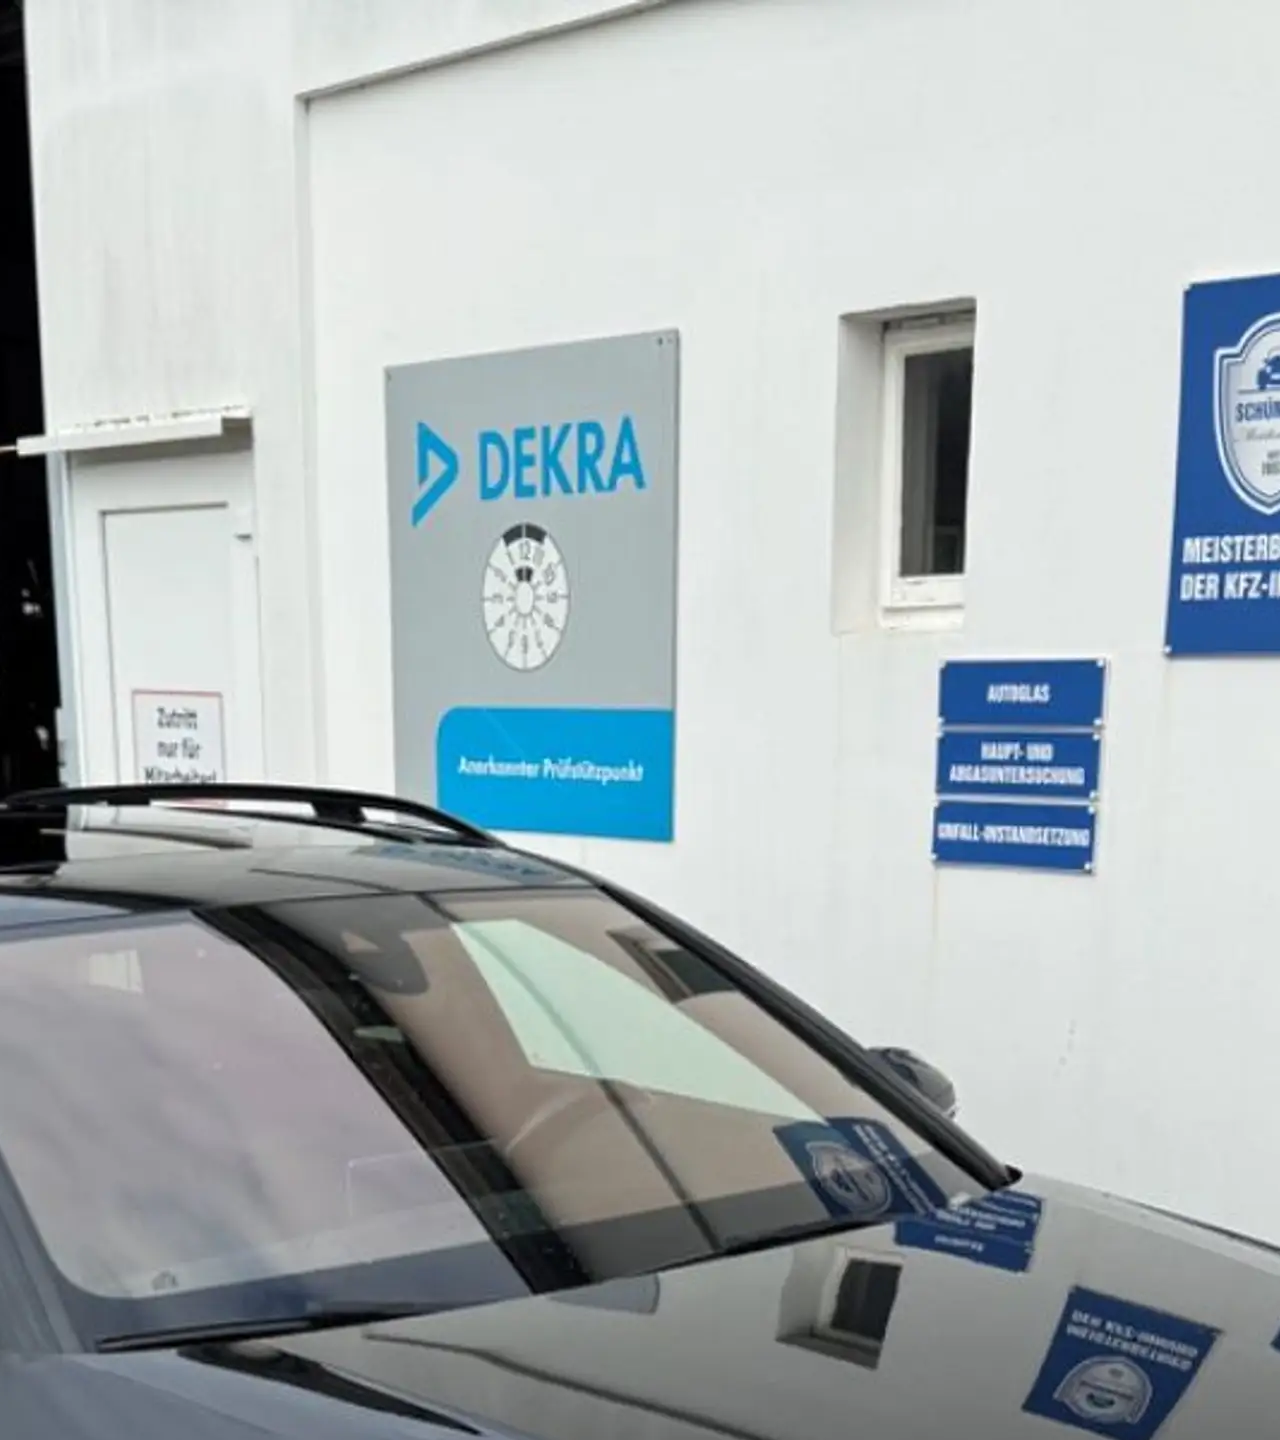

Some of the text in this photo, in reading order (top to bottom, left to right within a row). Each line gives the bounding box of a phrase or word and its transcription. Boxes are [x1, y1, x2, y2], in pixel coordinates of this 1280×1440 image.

[477, 415, 647, 502] DEKRA
[1179, 573, 1219, 601] DER
[986, 683, 1051, 703] AUTOGLAS
[457, 754, 540, 779] Anerkannter
